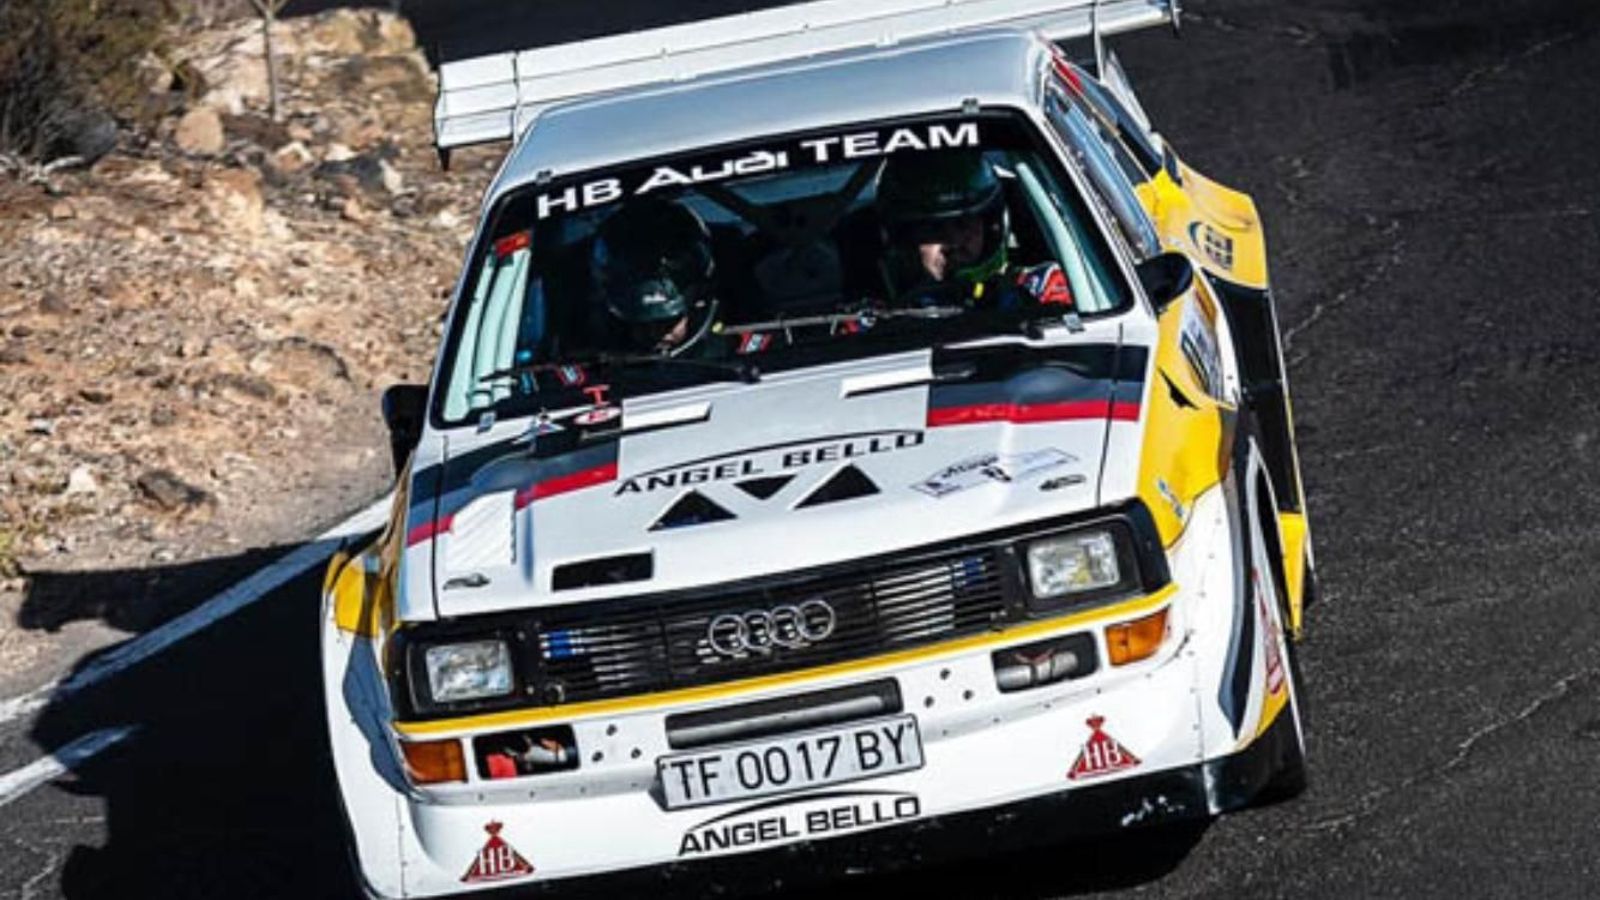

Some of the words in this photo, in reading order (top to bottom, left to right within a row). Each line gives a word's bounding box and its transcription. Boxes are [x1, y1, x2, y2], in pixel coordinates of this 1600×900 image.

[537, 178, 623, 219] HB
[800, 122, 979, 163] TEAM
[614, 459, 764, 497] ANGEL
[782, 431, 925, 468] BELLO
[671, 755, 722, 800] TF
[736, 735, 841, 790] 0017
[855, 723, 906, 771] BY
[1084, 741, 1122, 770] HB
[678, 816, 800, 857] ANGEL
[805, 796, 921, 834] BELLO
[479, 847, 515, 875] HB
